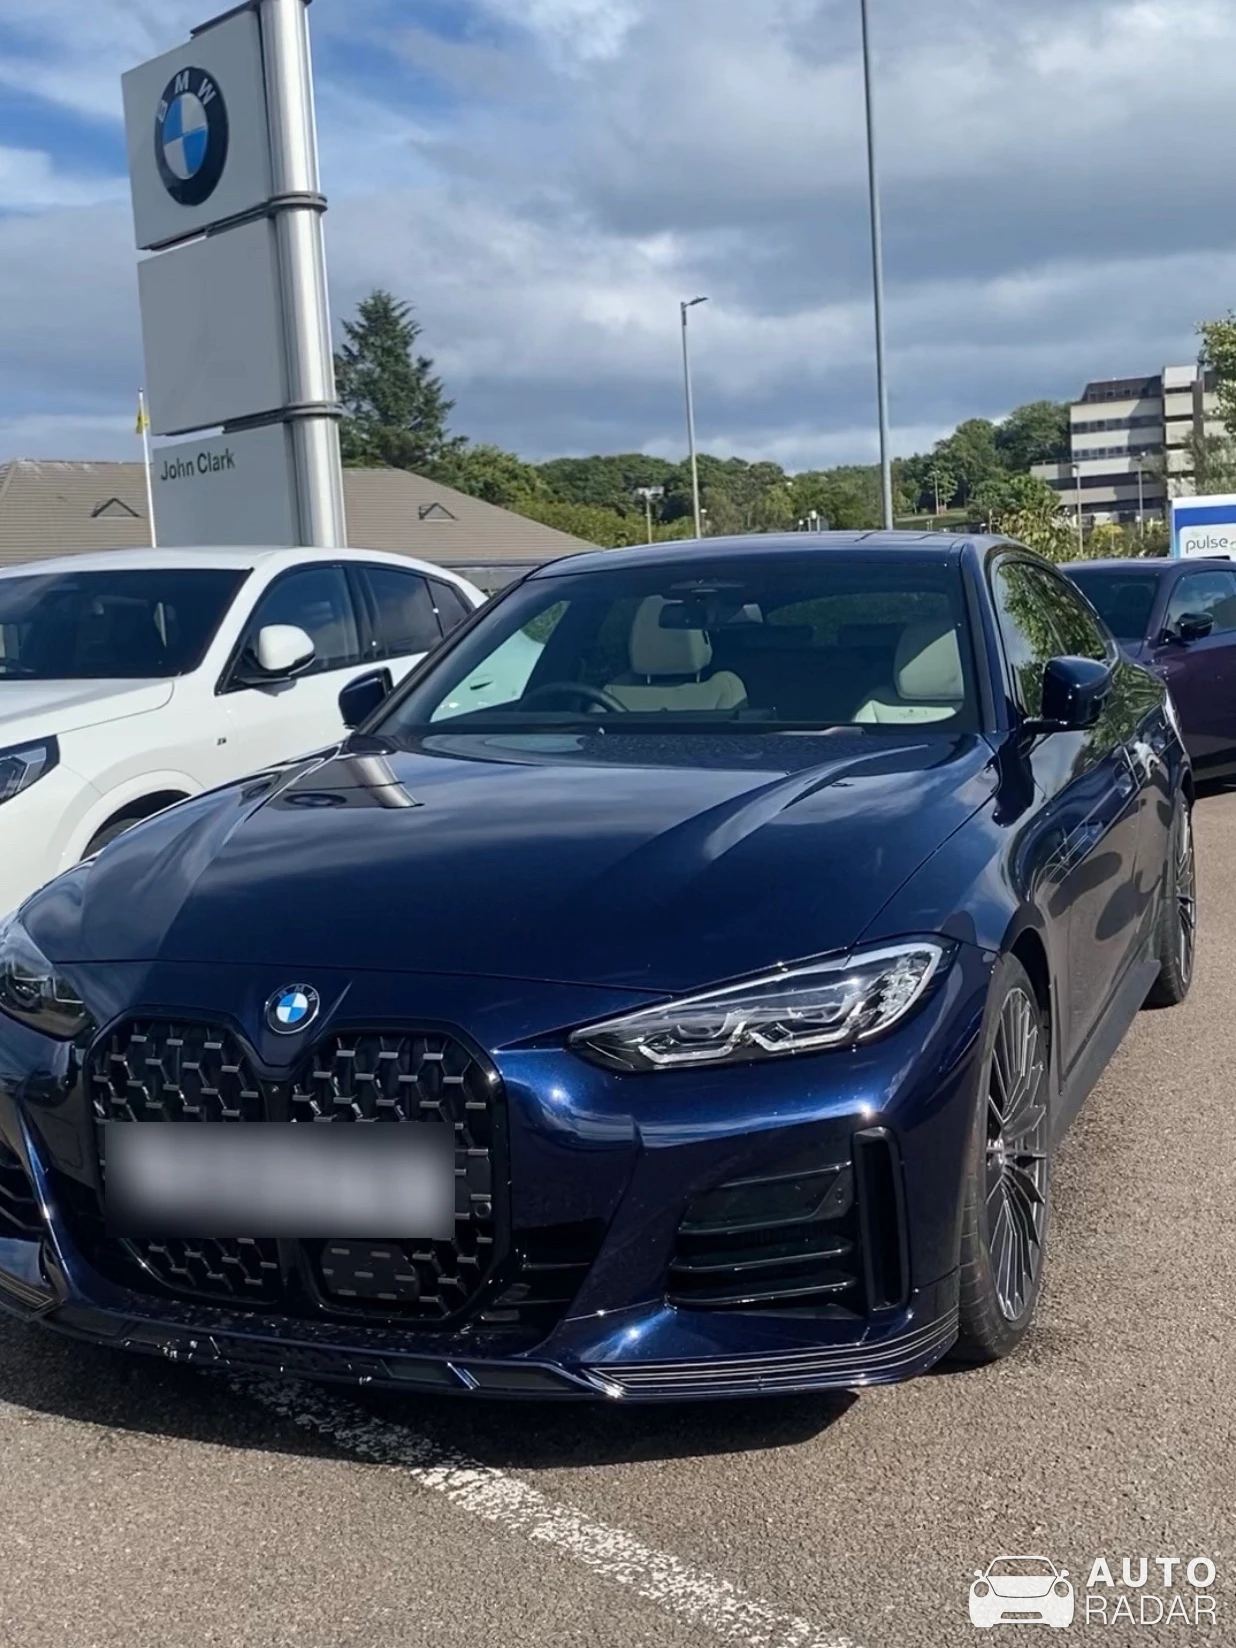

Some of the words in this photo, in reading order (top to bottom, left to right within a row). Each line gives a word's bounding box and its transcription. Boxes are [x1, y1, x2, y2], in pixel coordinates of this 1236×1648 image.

[160, 456, 195, 481] John
[197, 447, 236, 474] Clark
[1185, 534, 1229, 554] pulse
